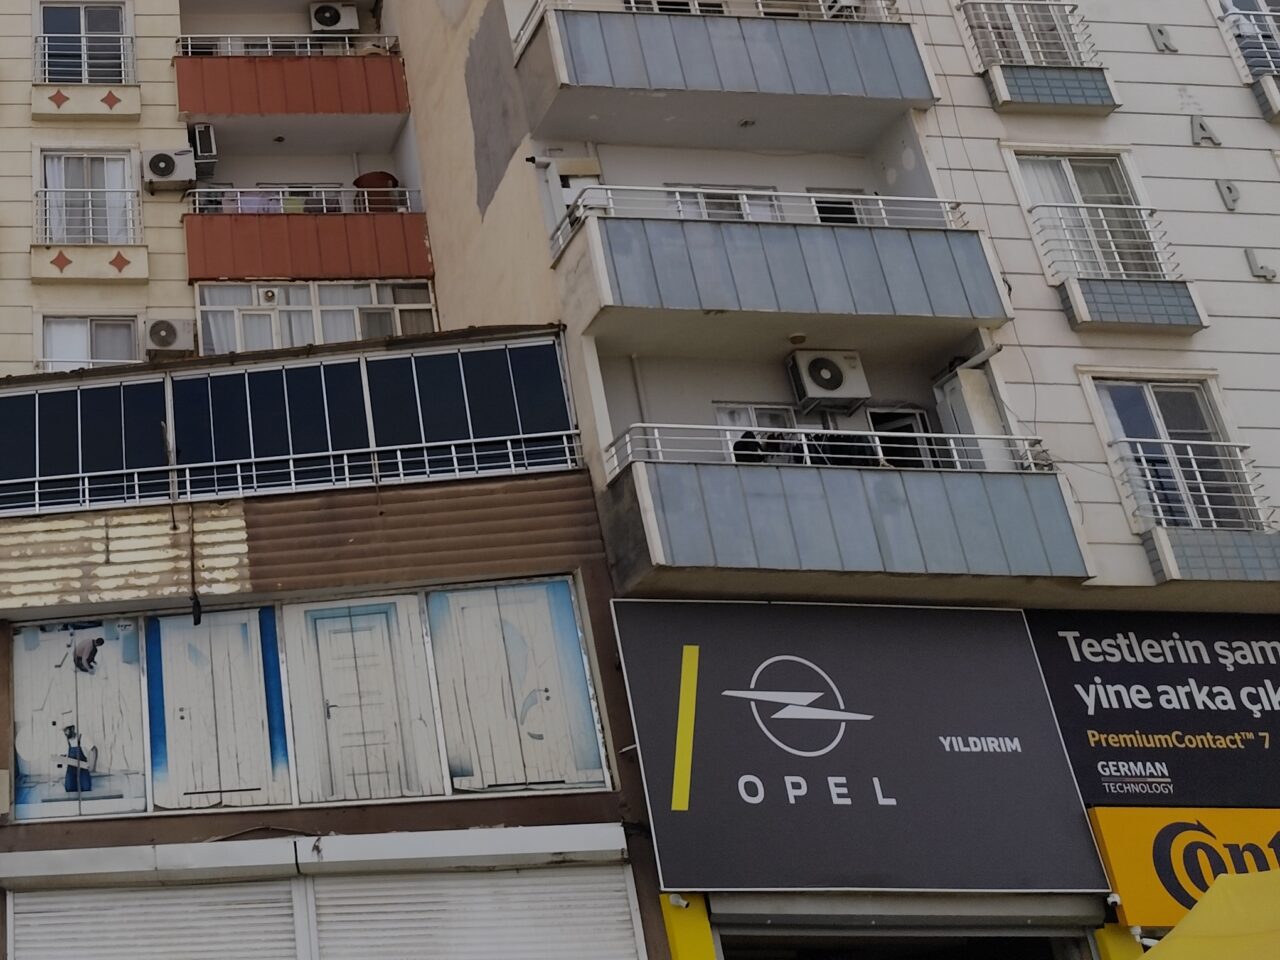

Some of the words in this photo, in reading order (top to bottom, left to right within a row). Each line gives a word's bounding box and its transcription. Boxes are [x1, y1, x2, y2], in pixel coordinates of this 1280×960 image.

[1057, 631, 1211, 664] Testlerin
[1074, 676, 1153, 715] yine
[1157, 678, 1236, 710] arka
[939, 736, 1022, 753] YILDIRIM
[1258, 731, 1270, 749] 7
[1097, 761, 1169, 777] GERMAN
[737, 774, 897, 806] OPEL
[1102, 782, 1174, 794] TECHNOLOGY
